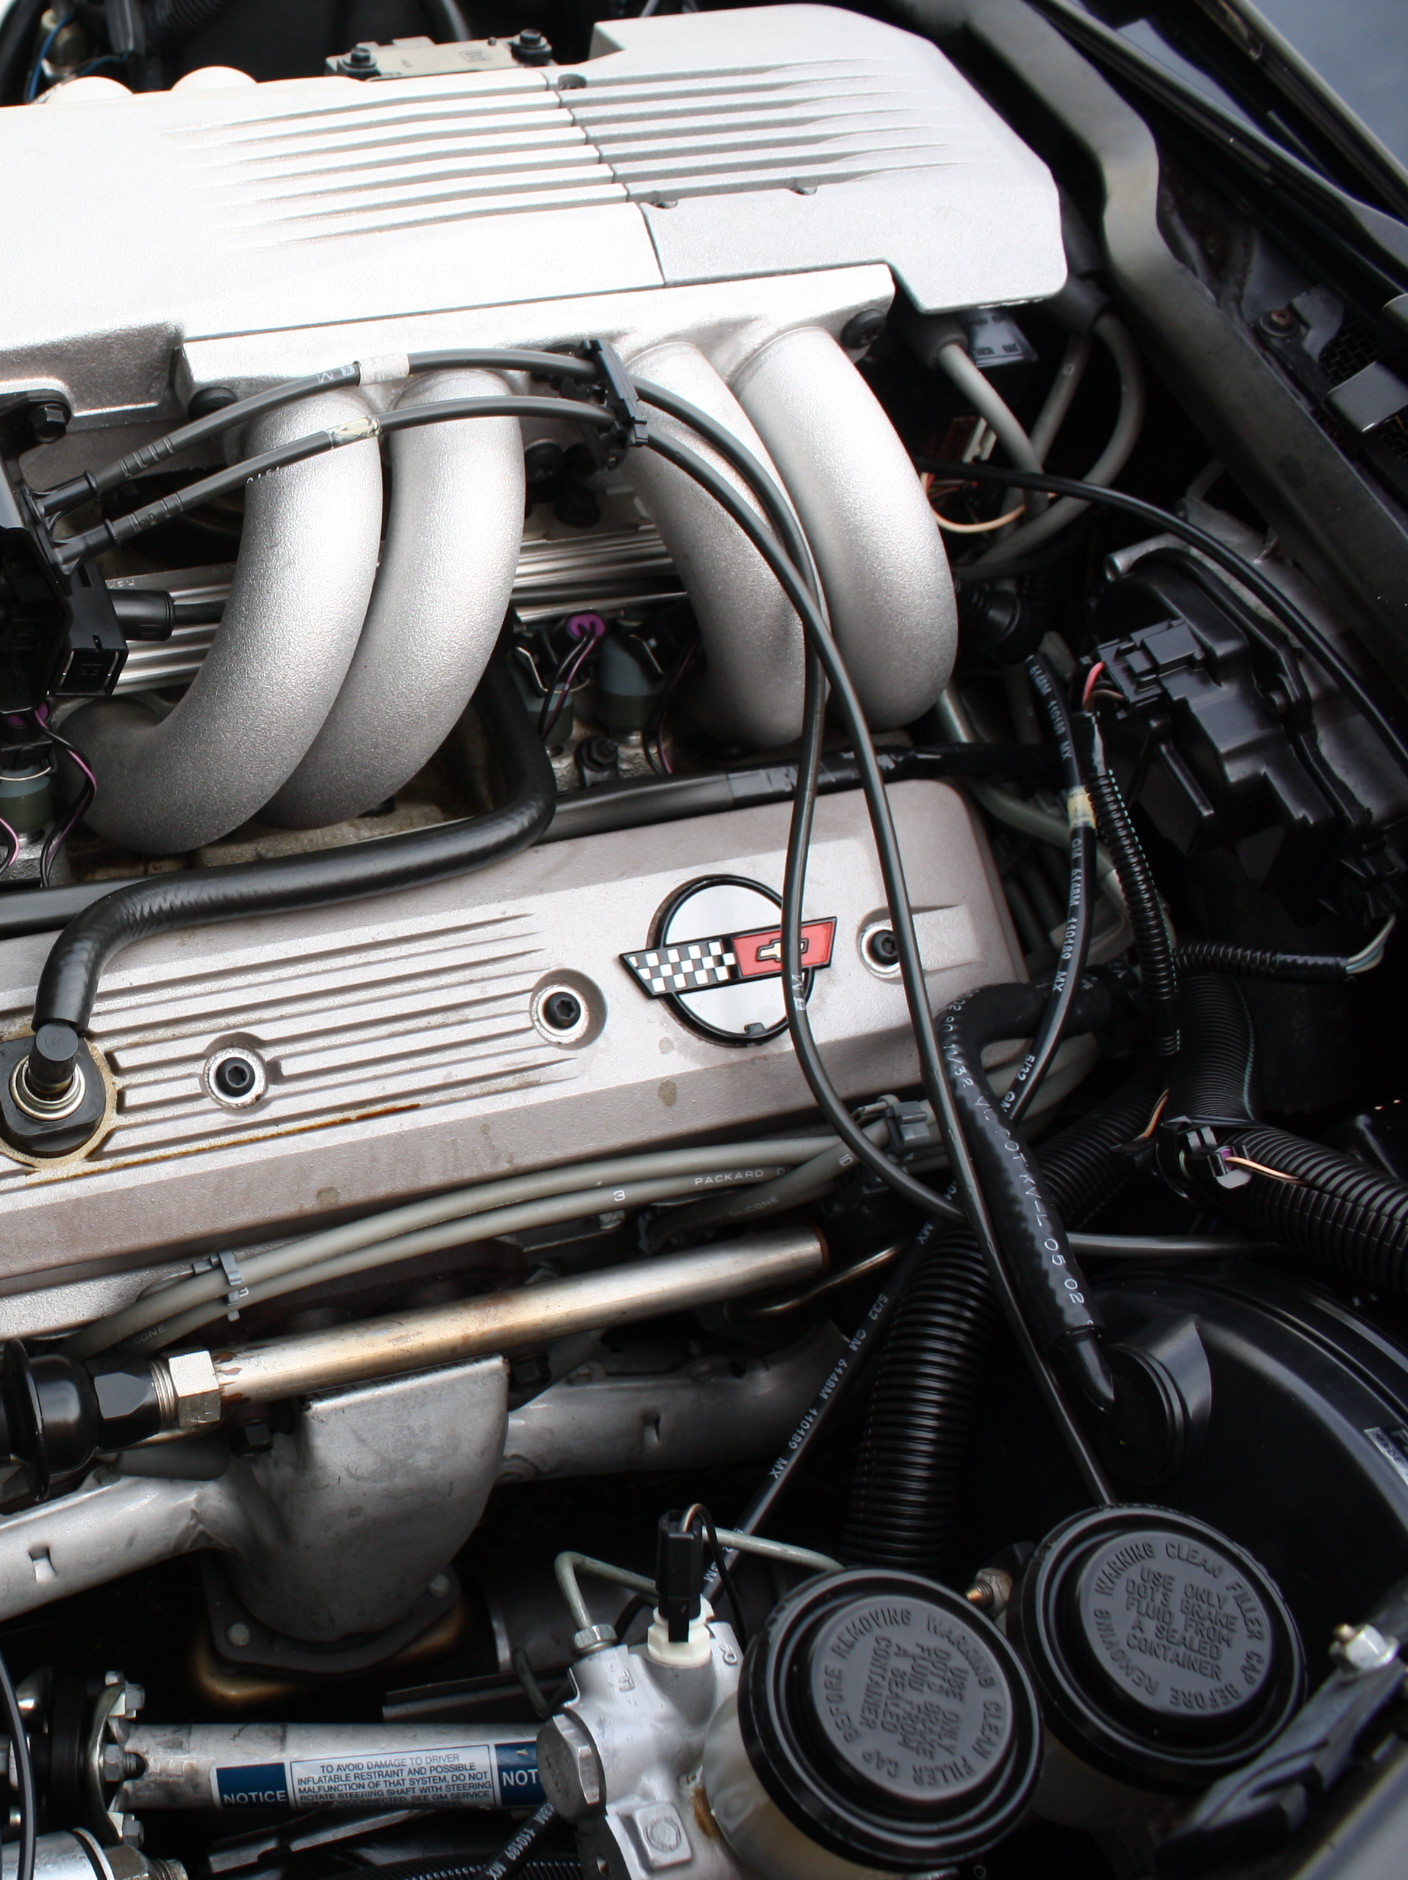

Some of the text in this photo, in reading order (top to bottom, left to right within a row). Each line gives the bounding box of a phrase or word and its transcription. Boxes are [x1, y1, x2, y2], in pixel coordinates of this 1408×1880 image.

[1060, 740, 1073, 761] MX
[1052, 970, 1068, 993] MX
[694, 1169, 765, 1186] PACKARD
[1064, 1278, 1085, 1304] 02
[868, 1293, 889, 1321] 5/32
[848, 1328, 867, 1351] GM
[769, 1457, 788, 1479] MX
[1140, 1566, 1227, 1610] USE ONLY
[1093, 1542, 1265, 1710] WARNING CLEAN FILLER CAP BEFORE REMOVING
[1126, 1595, 1233, 1649] FLUID FROM
[1180, 1598, 1237, 1633] BRAKE
[830, 1607, 911, 1660] REMOVING
[1131, 1616, 1222, 1661] A SEALED
[1126, 1634, 1222, 1682] CONTAINER
[859, 1635, 891, 1730] CONTAINER
[897, 1641, 931, 1751] FLUID FROM
[823, 1664, 862, 1745] BEFORE
[880, 1667, 907, 1733] SEALED
[937, 1665, 969, 1756] USE ONLY
[916, 1700, 941, 1760] BRAKE
[971, 1699, 1003, 1760] CLEAN
[297, 1762, 476, 1786] INFLATABLE RESTRAINT AND POSSIBLE
[320, 1753, 460, 1774] TO AVOID DAMAGE TO DRIVER
[862, 1749, 899, 1778] CAP
[911, 1755, 975, 1786] FILLER
[223, 1790, 287, 1805] NOTICE
[298, 1771, 489, 1794] MALFUNCTION OF THAT SYSTEM, DO NOT
[300, 1781, 492, 1801] ROTATE STEERING SHAFT WITH STEERING
[411, 1793, 430, 1801] SEE
[431, 1793, 448, 1801] GM
[450, 1790, 491, 1800] SERVICE
